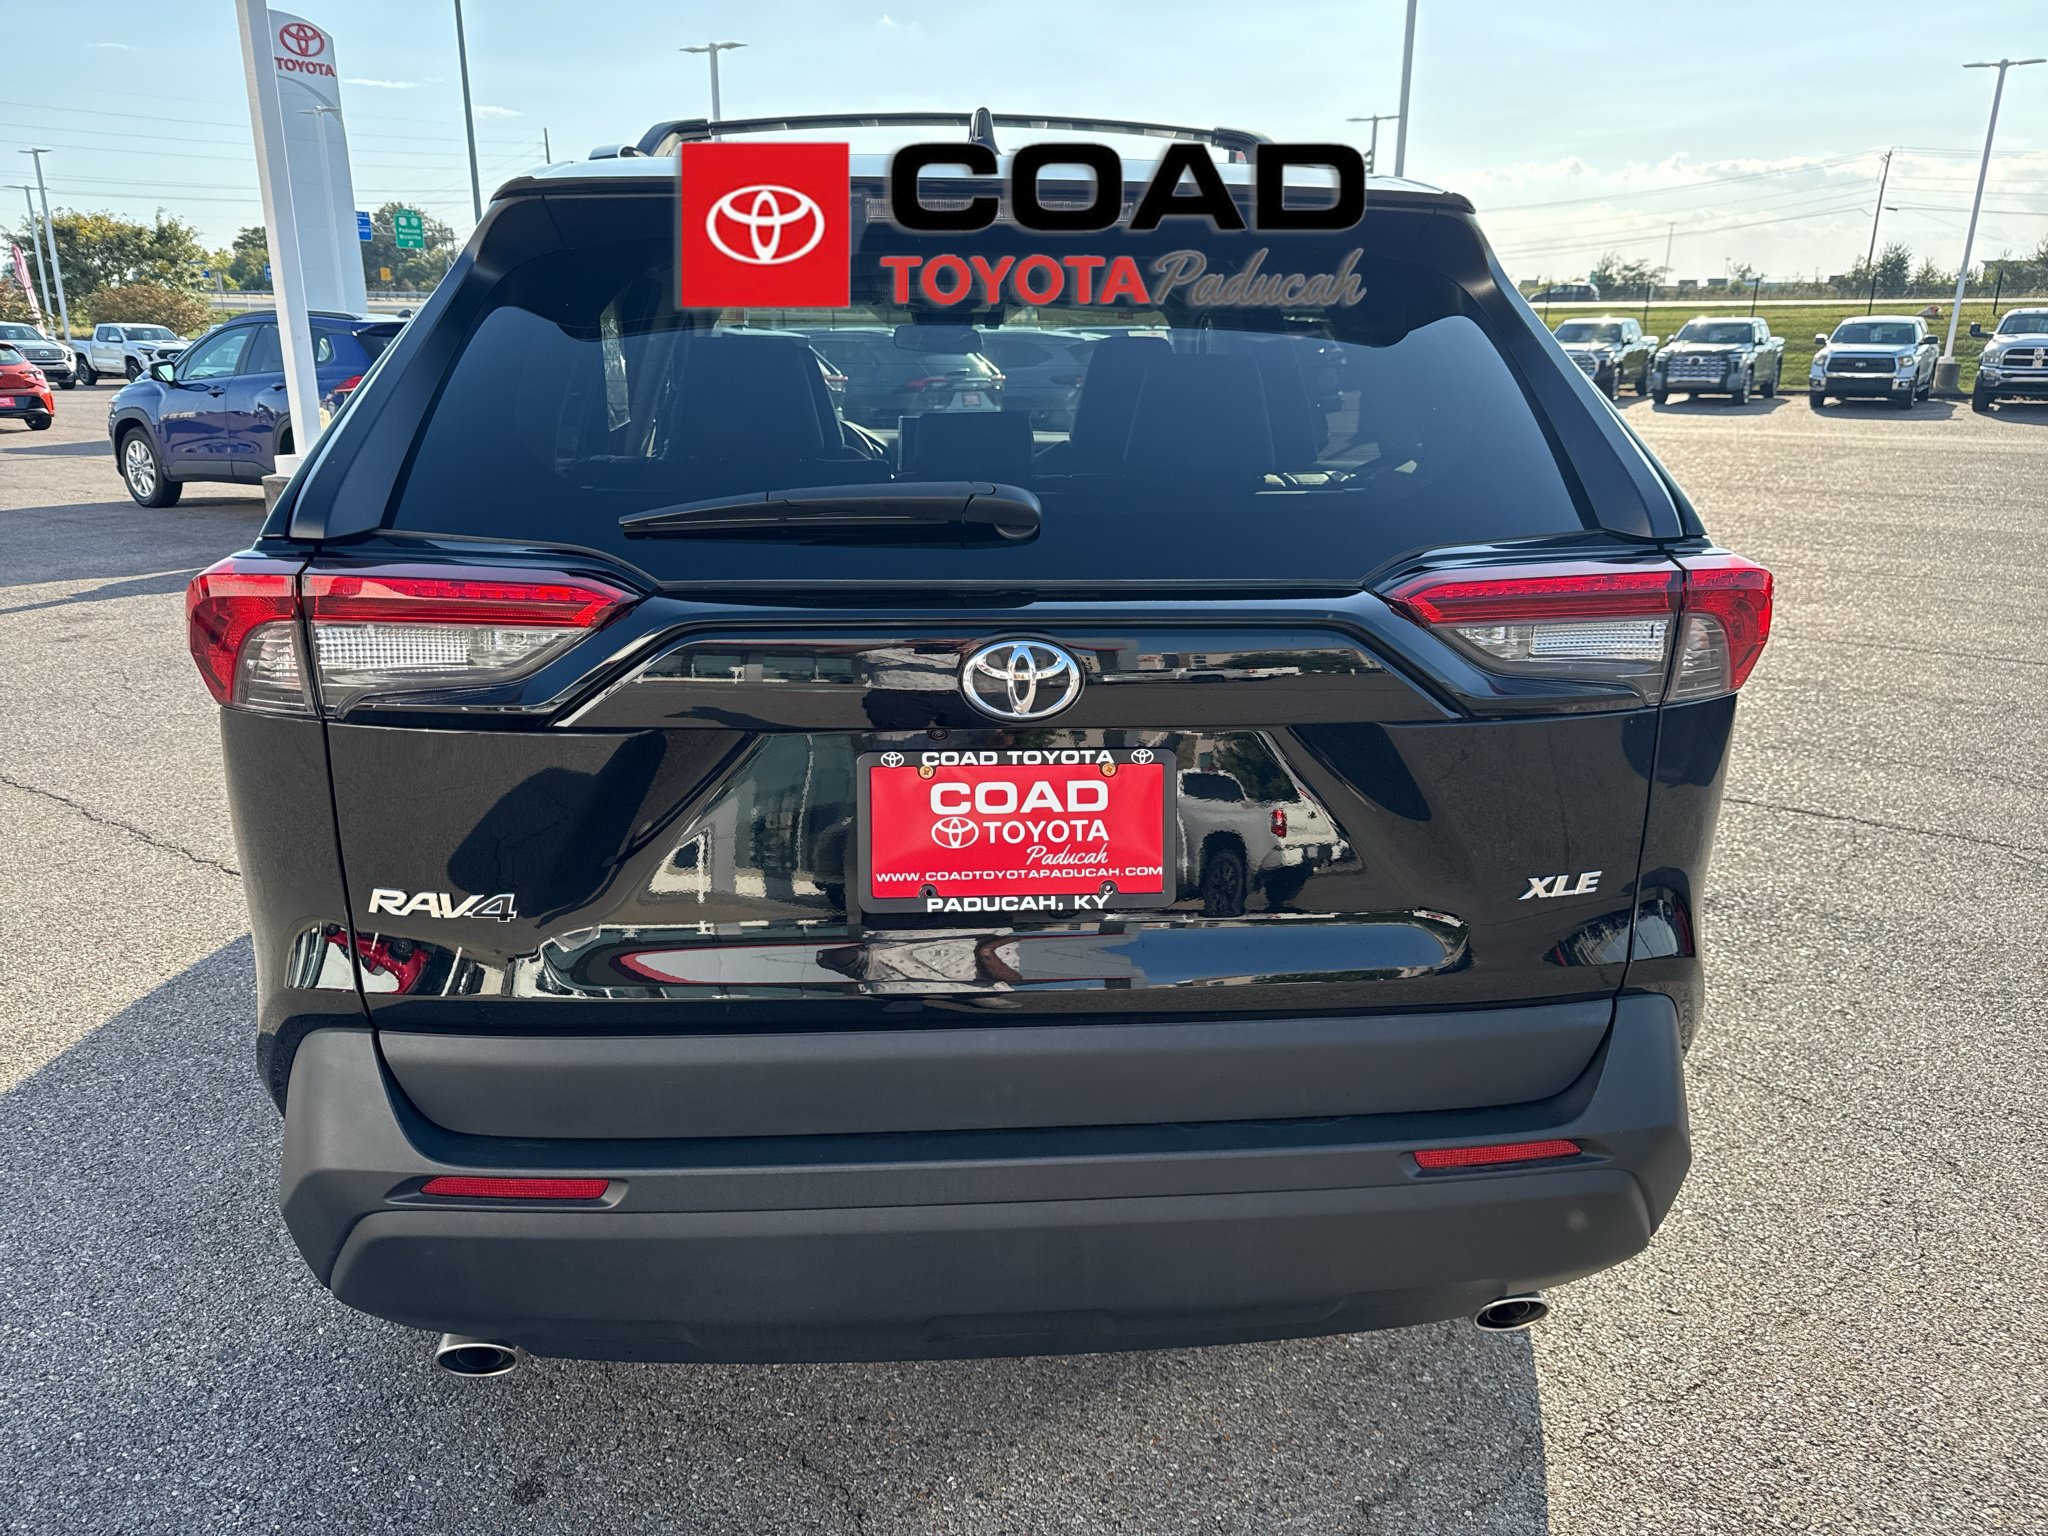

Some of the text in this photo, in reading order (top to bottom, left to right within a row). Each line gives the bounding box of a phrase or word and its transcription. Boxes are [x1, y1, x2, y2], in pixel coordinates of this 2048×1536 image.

[274, 56, 336, 77] TOYOTA
[921, 749, 1115, 767] COAD TOYOTA
[930, 780, 1109, 815] COAD
[983, 819, 1110, 846] TOYOTA
[1026, 843, 1109, 866] Paducah
[876, 866, 1163, 883] WWW.COADTOYOTAPADUCAH.COM
[1518, 870, 1603, 901] XLE
[368, 888, 518, 923] RAV4
[926, 894, 1111, 913] PADUCAH, KY
